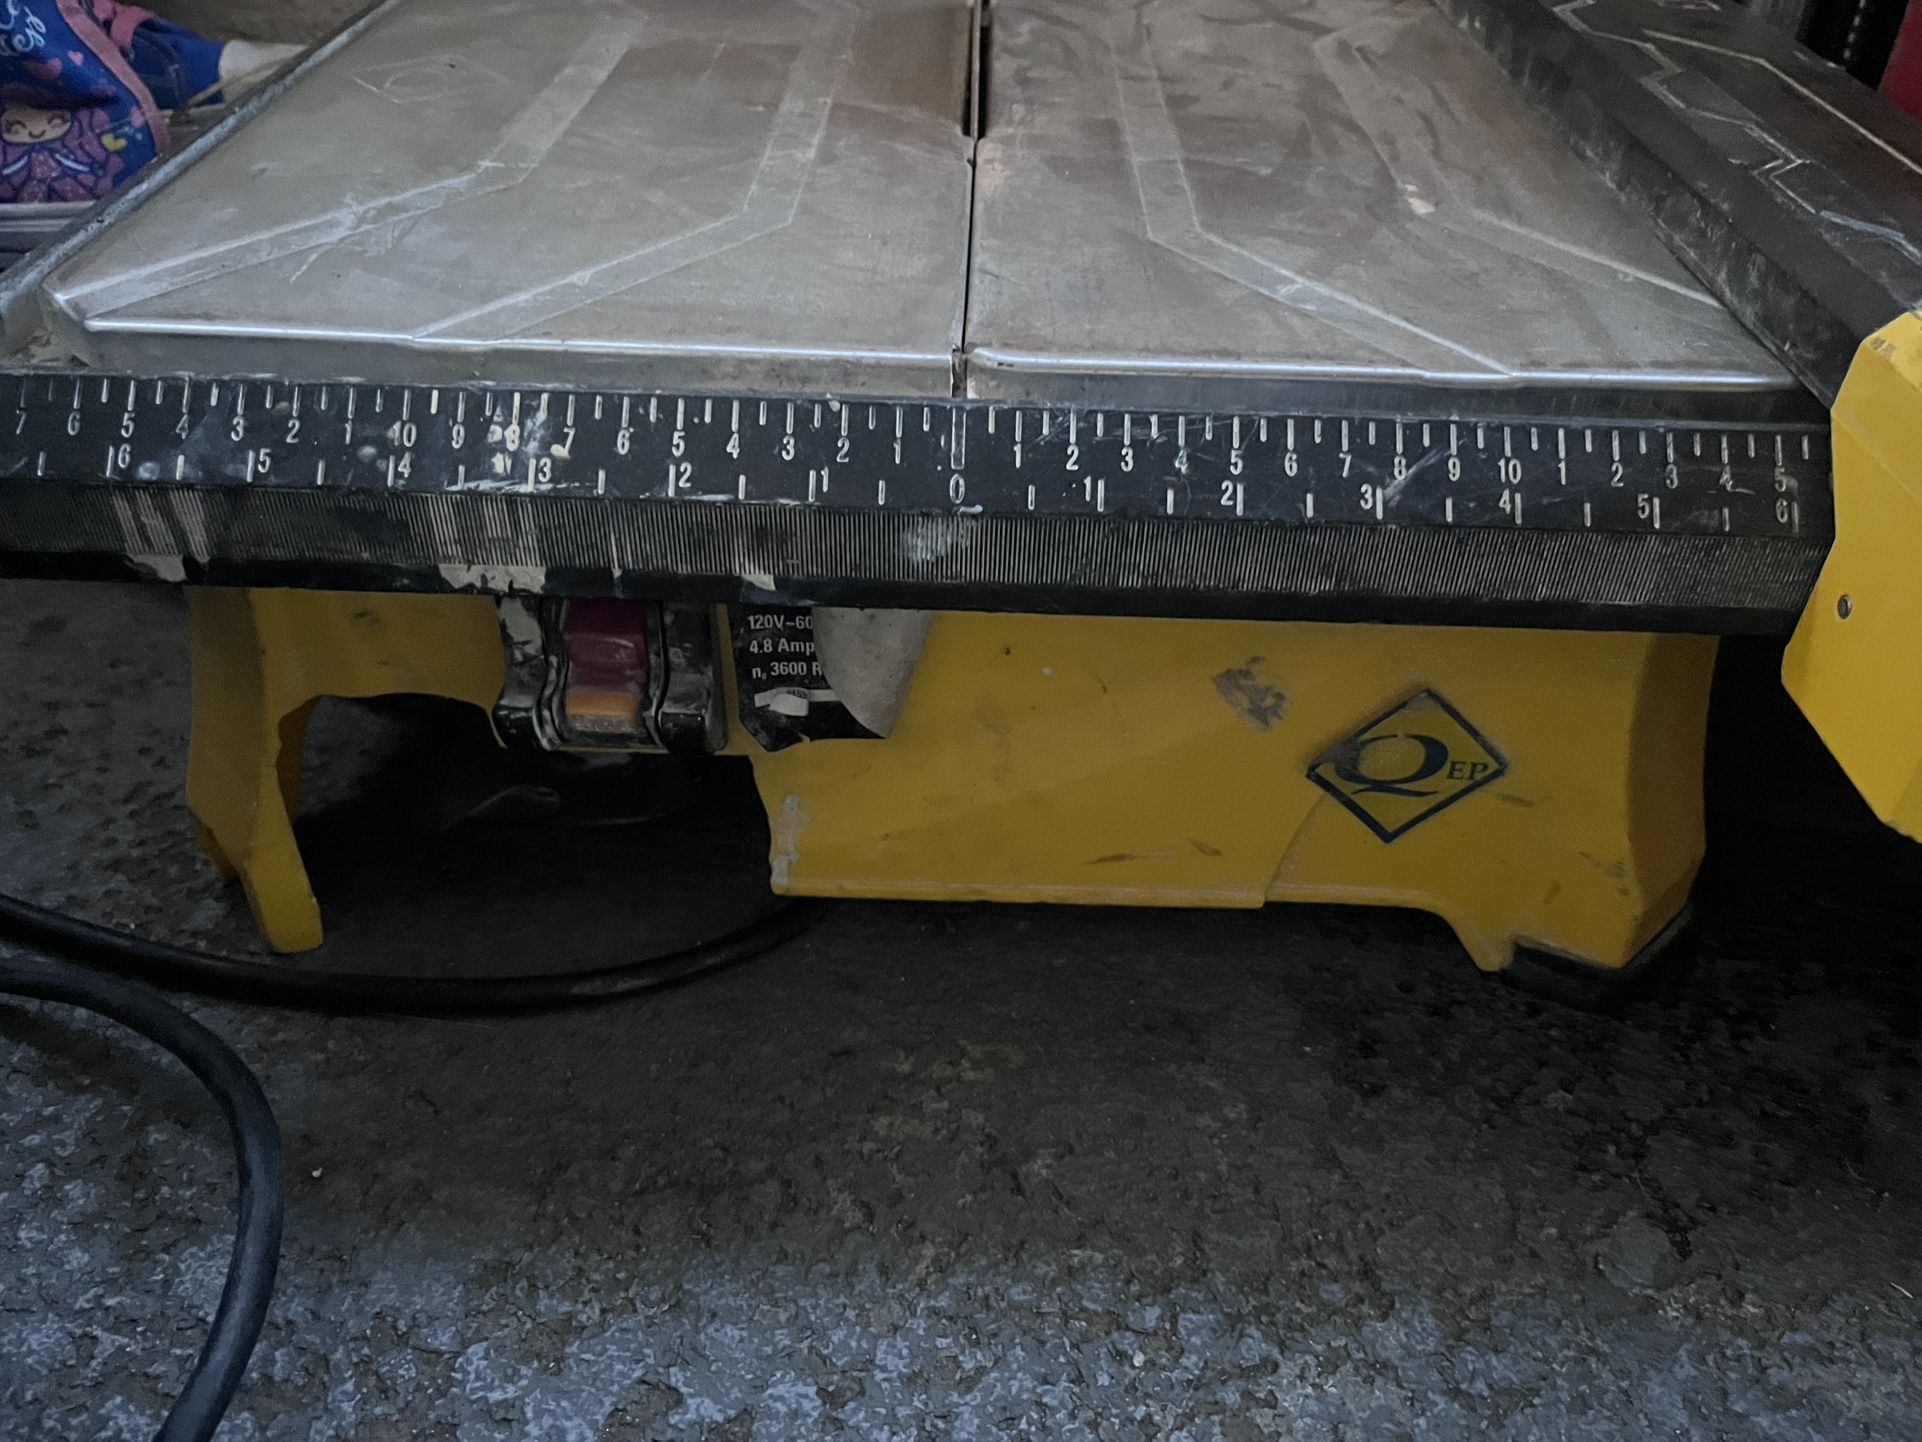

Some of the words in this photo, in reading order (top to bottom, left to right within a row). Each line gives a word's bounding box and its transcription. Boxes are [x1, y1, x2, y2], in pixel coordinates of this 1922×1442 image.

[16, 409, 26, 434] 7
[67, 411, 80, 436] 6
[121, 412, 135, 438] 5
[176, 413, 190, 439] 4
[231, 416, 245, 442] 3
[286, 418, 300, 444] 2
[344, 421, 351, 445] 1
[452, 423, 465, 449] 9
[505, 425, 520, 452] 8
[562, 427, 575, 453] 7
[617, 430, 630, 455] 6
[671, 432, 685, 457] 5
[726, 433, 739, 459] 4
[781, 435, 795, 460] 3
[836, 438, 850, 463] 2
[893, 439, 901, 464] 1
[1013, 443, 1022, 469] 1
[1066, 445, 1079, 471] 2
[1121, 446, 1133, 472] 3
[1175, 449, 1188, 474] 4
[1230, 450, 1243, 475] 5
[1284, 451, 1298, 477] 6
[1339, 453, 1352, 478] 7
[1393, 455, 1406, 480] 8
[1447, 457, 1461, 481] 9
[1497, 458, 1522, 484] 10
[1558, 459, 1567, 485] 1
[1610, 461, 1624, 487] 2
[1664, 463, 1679, 489] 3
[1718, 465, 1733, 490] 4
[1773, 466, 1787, 492] 5
[117, 444, 131, 469] 6
[257, 448, 271, 473] 5
[398, 452, 411, 478] 4
[538, 457, 551, 483] 3
[679, 463, 692, 488] 2
[820, 466, 829, 492] 1
[950, 473, 966, 504] 0
[1083, 476, 1092, 501] 1
[1220, 480, 1234, 505] 2
[1359, 484, 1373, 510] 3
[1498, 488, 1511, 515] 4
[1637, 493, 1650, 519] 5
[1775, 497, 1789, 524] 6
[749, 638, 773, 654] 4.8
[777, 637, 815, 656] Amp
[769, 661, 808, 676] 3600
[1334, 733, 1489, 797] QEP
